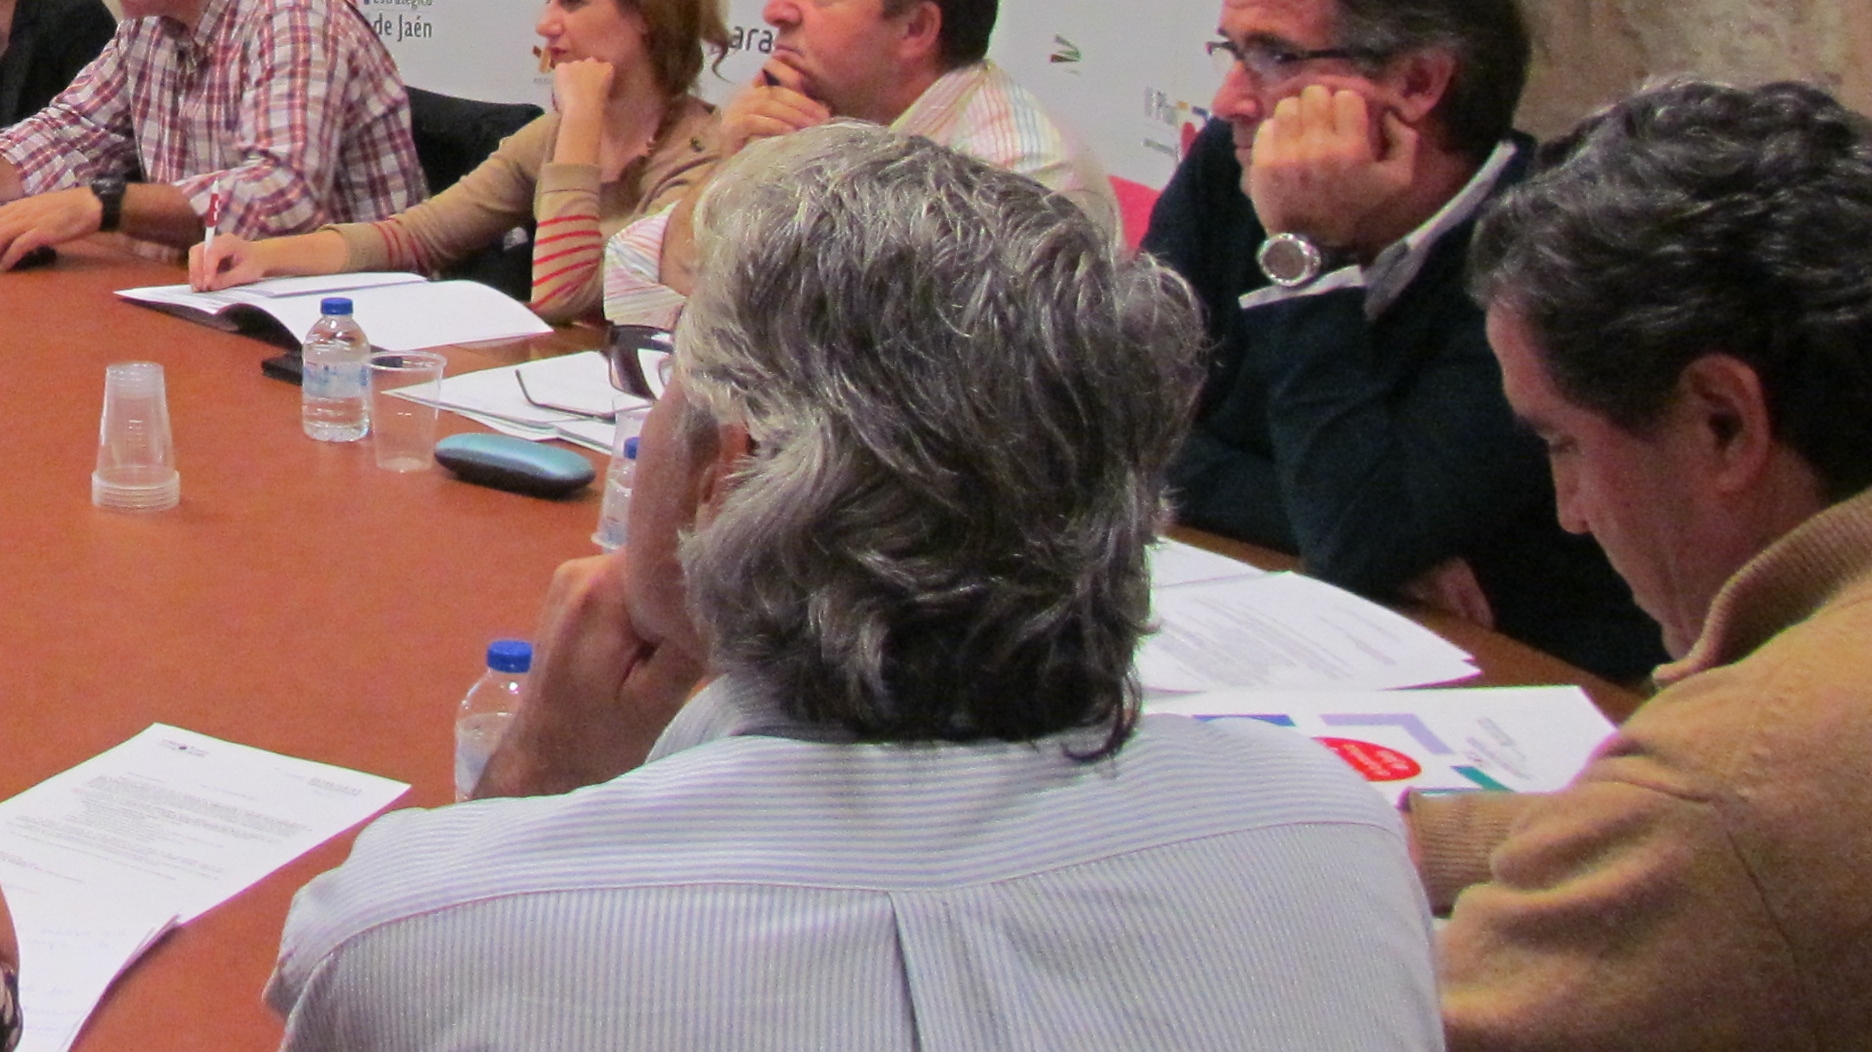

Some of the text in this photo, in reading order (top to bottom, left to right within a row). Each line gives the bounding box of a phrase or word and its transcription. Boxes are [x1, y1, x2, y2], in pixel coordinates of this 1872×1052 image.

[374, 12, 432, 42] de Jaén
[729, 25, 773, 54] ara
